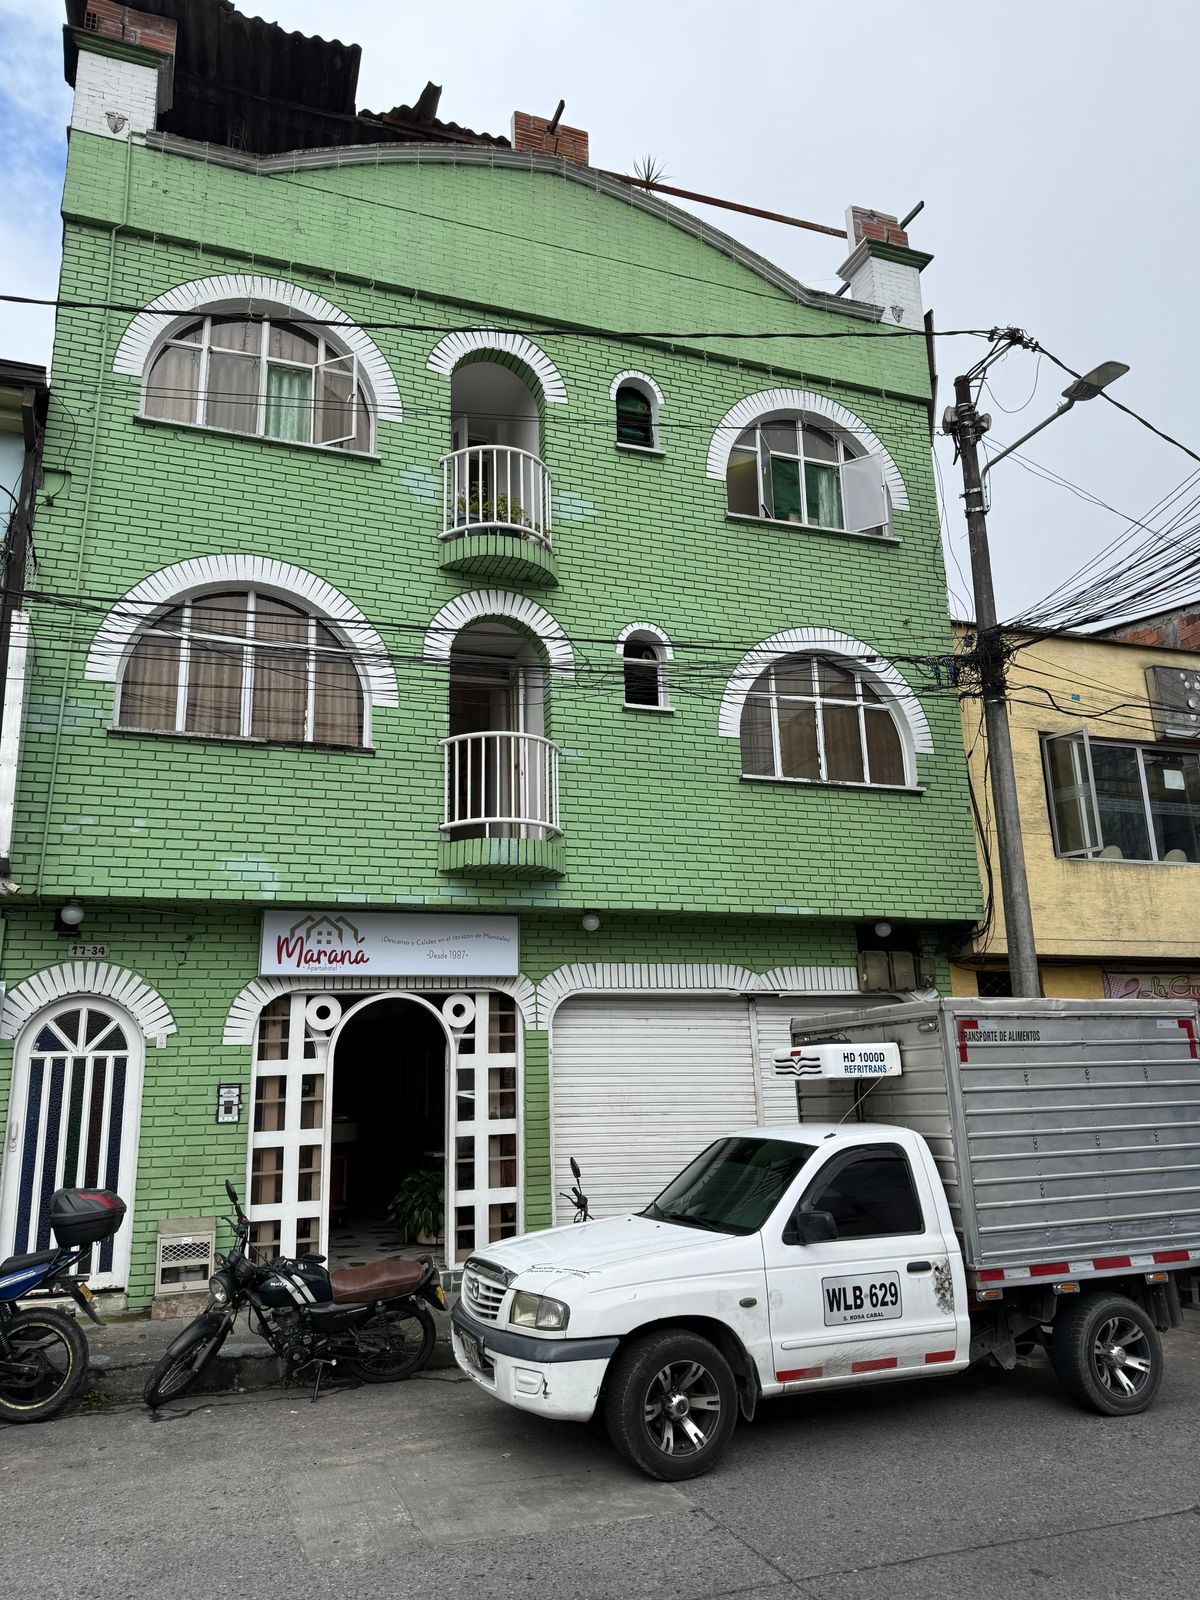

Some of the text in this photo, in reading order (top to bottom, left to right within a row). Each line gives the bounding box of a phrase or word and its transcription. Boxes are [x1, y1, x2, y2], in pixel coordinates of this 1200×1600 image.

[72, 945, 106, 956] 17-34
[277, 935, 370, 968] Maraná
[1141, 976, 1168, 998] La
[960, 1030, 1041, 1042] TRANSPORTE DE ALIMENTOS
[843, 1052, 856, 1063] HD
[844, 1064, 888, 1074] REFRITRANS
